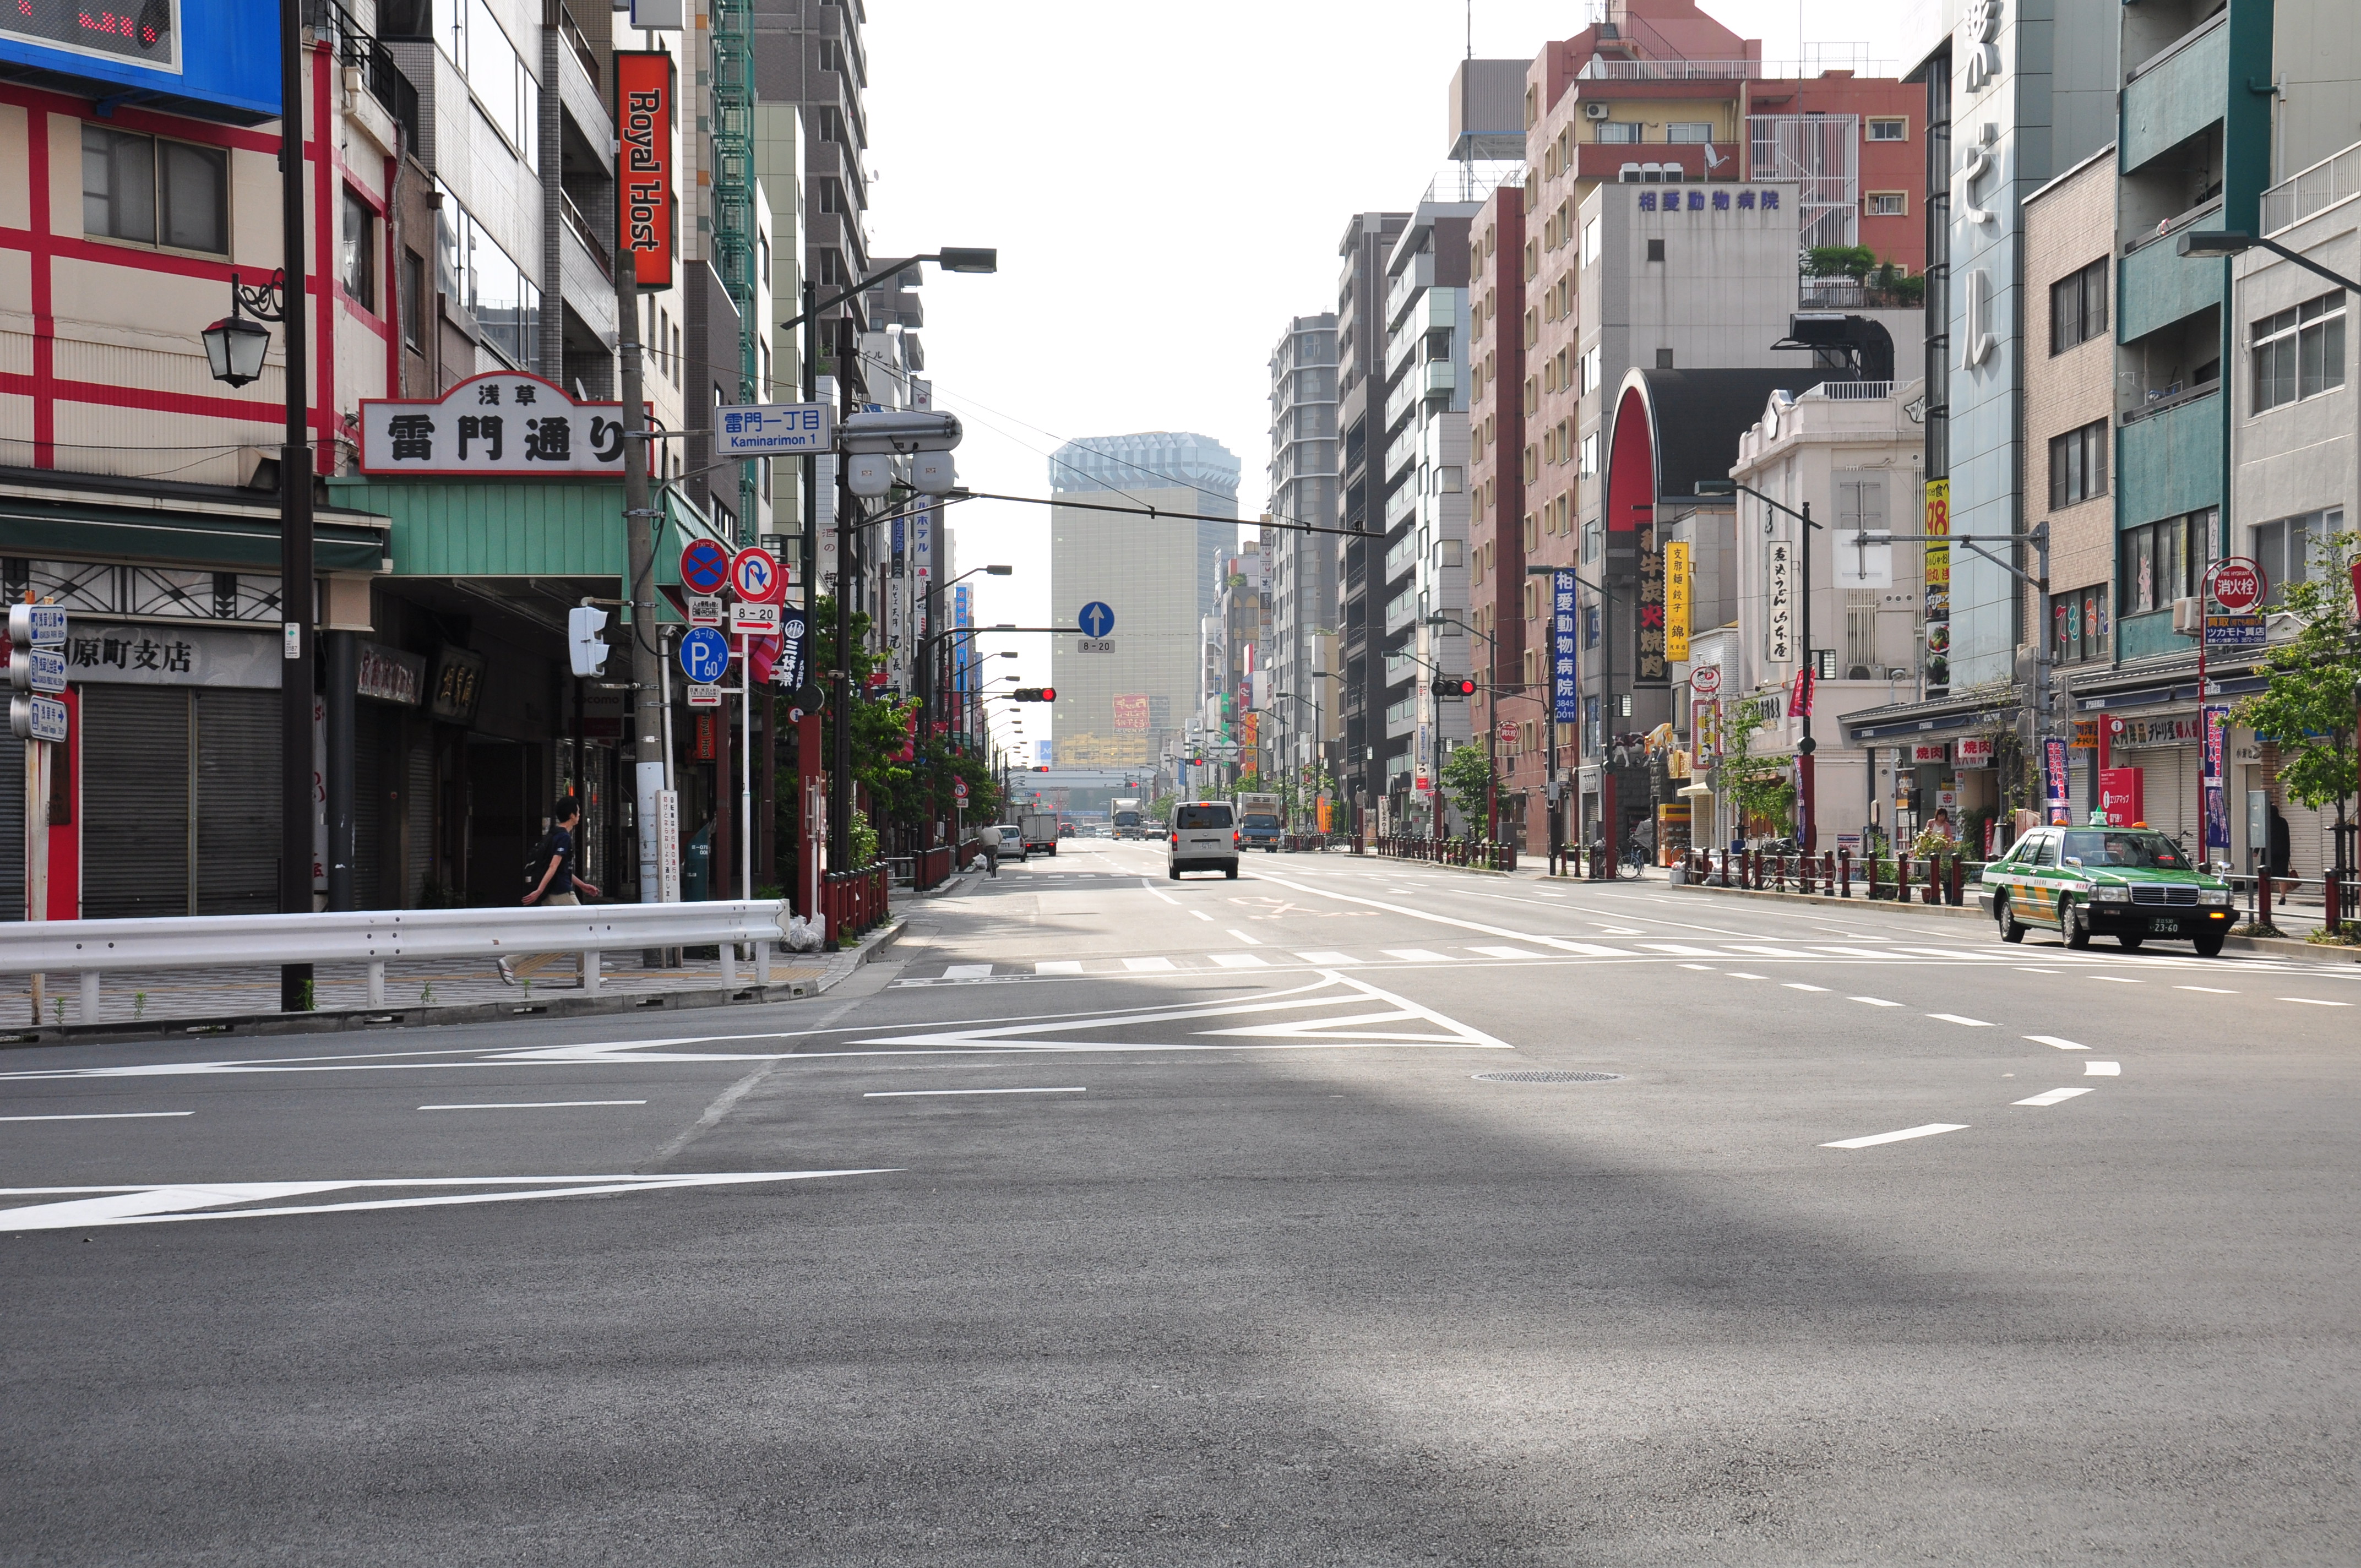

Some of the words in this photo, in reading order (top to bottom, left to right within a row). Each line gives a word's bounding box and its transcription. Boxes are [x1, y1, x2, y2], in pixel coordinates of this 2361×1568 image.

[624, 88, 661, 173] Royal
[1639, 190, 1779, 212] 相愛動物病院
[629, 180, 661, 253] Host
[478, 384, 536, 406] 浅草
[725, 410, 819, 434] 雷門一丁目
[388, 413, 624, 462] 雷門通り
[731, 435, 806, 448] Kaminarimon
[810, 434, 816, 445] 1
[916, 494, 928, 553] ルホテル
[1927, 499, 1949, 537] 98
[2217, 578, 2255, 596] 消火栓
[2055, 595, 2109, 643] てもみん
[2207, 617, 2229, 627] 買取
[695, 630, 714, 639] 9-19
[1557, 571, 1574, 696] 相愛動物病院
[1672, 624, 1684, 640] 錦
[1774, 611, 1788, 657] 山本屋
[2207, 627, 2265, 637] ツカモト質店
[691, 642, 710, 676] P
[704, 661, 718, 676] 60
[701, 741, 710, 758] Host
[1916, 746, 1943, 759] 焼肉
[1963, 740, 1992, 754] 焼肉
[2110, 794, 2129, 803] エリアマップ
[2155, 923, 2178, 932] 23-60
